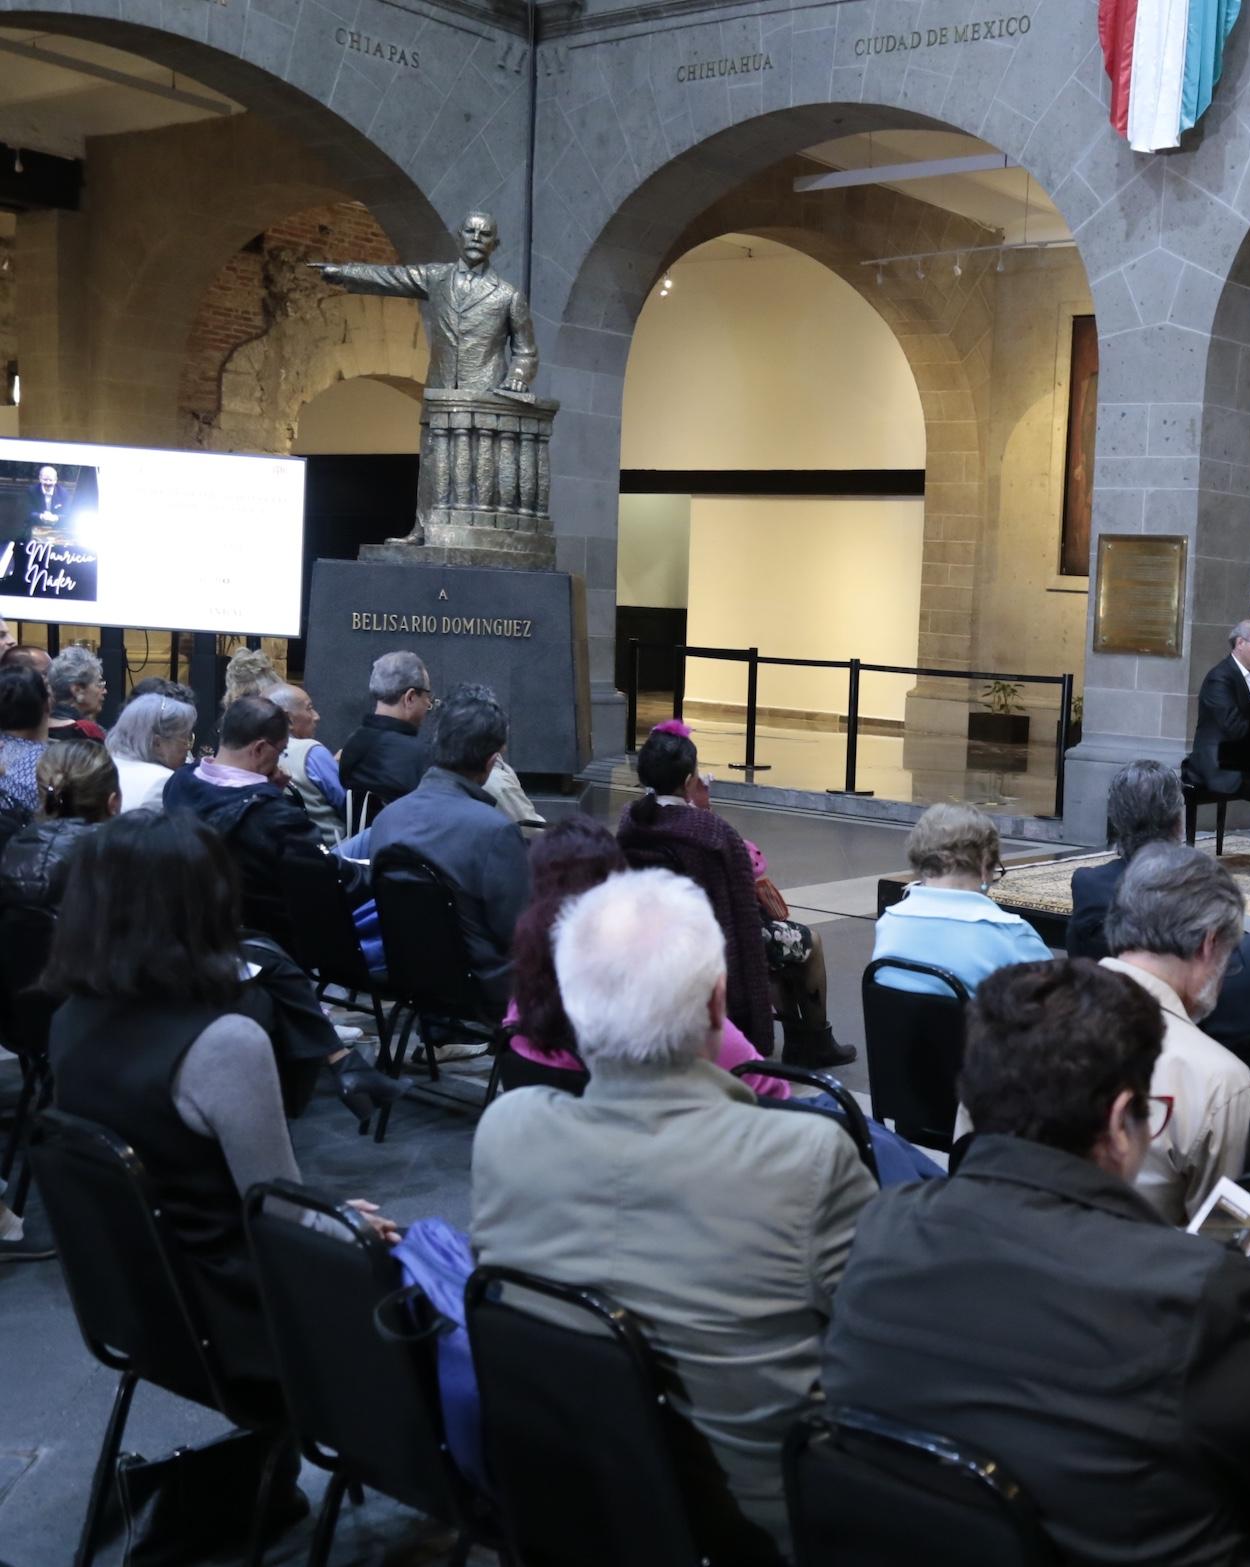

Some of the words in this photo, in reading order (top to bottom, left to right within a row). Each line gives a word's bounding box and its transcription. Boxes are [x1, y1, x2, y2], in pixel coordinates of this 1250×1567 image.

[335, 27, 420, 69] CHIAPAS
[854, 31, 922, 56] CIUDAD
[927, 27, 949, 48] DE
[954, 15, 1031, 44] MEXICO
[677, 53, 773, 82] CHIHUAHUA
[26, 540, 97, 570] Mauricio
[438, 588, 448, 600] A
[352, 612, 437, 633] BELISARIO
[442, 616, 532, 638] DOMINGUEZ
